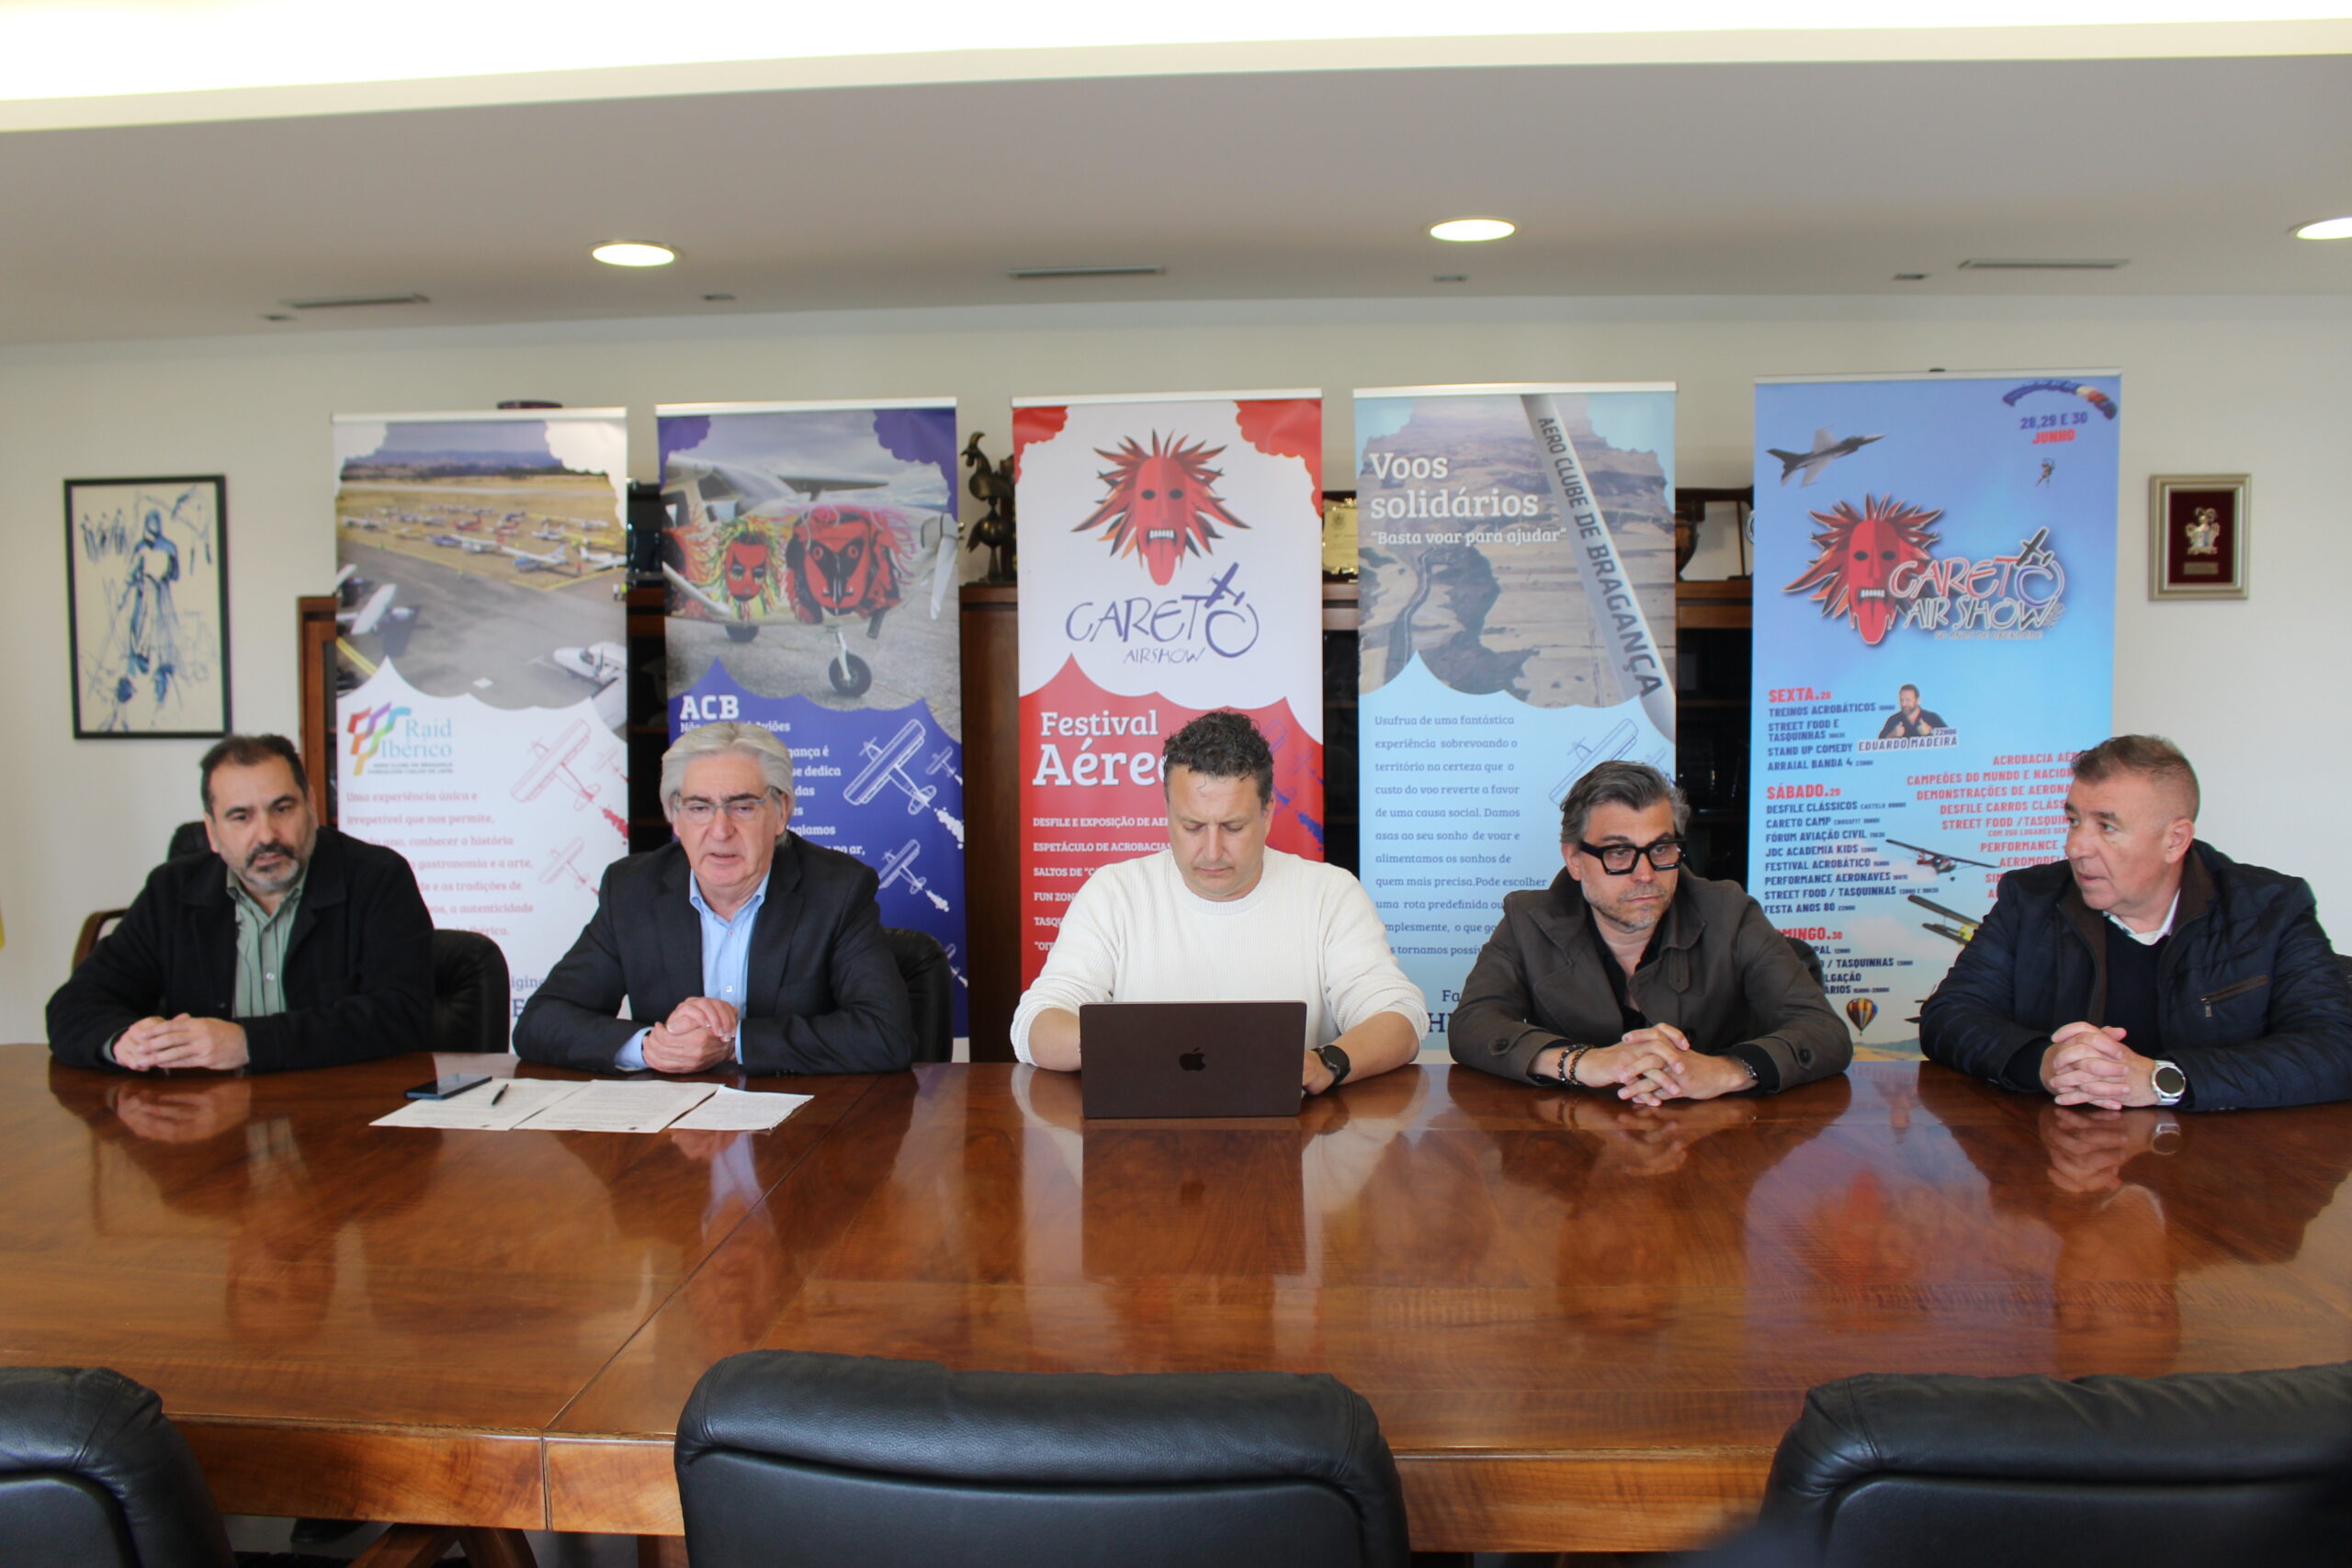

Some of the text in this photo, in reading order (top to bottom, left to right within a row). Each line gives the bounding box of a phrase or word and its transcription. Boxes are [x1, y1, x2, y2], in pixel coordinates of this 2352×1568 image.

[2020, 412, 2088, 430] 28,29 E 30
[2031, 429, 2075, 445] JUNHO
[1370, 452, 1449, 479] Voos
[1370, 487, 1539, 520] solidários
[1426, 531, 1462, 544] voar
[1465, 531, 1503, 547] para
[1538, 417, 1663, 697] AERO CLUBE DE BRAGANÇA
[1889, 556, 2065, 608] CARETO
[1903, 596, 1951, 629] AIR
[1951, 593, 2058, 630] SHOW
[1066, 594, 1259, 659] CARETO
[1123, 647, 1206, 664] AIRSHOW
[679, 694, 740, 720] ACB
[1769, 706, 1809, 717] TREINOS
[1812, 703, 1876, 715] ACROBÁTICOS
[1040, 709, 1159, 737] Festival
[1375, 716, 1417, 726] Usufrua
[1419, 716, 1432, 725] de
[1460, 715, 1514, 725] fantástica
[1768, 718, 1839, 732] STREET FOOD E
[405, 718, 452, 738] Raid
[1769, 730, 1826, 742] TASQUINHAS
[381, 739, 453, 759] Ibérico
[1375, 738, 1436, 750] experiência
[1441, 738, 1509, 748] sobrevoando
[1768, 743, 1853, 757] STAND UP COMEDY
[1859, 736, 1957, 751] EDUARDO MADEIRA
[822, 745, 829, 757] é
[1768, 757, 1853, 771] ARRAIAL BANDA 4
[1993, 753, 2052, 766] ACROBACIA
[804, 765, 841, 777] dedica
[1375, 761, 1424, 771] território
[1442, 762, 1482, 771] certeza
[1485, 763, 1503, 773] que
[1907, 769, 2030, 785] CAMPEÕES DO MUNDO E
[795, 785, 815, 796] das
[1375, 786, 1402, 795] custo
[1405, 784, 1418, 795] do
[1442, 786, 1480, 795] reverte
[1491, 784, 1521, 795] favor
[1917, 784, 2025, 801] DEMONSTRAÇÕES DE
[373, 791, 436, 804] experiência
[439, 791, 469, 801] única
[1375, 808, 1387, 818] de
[1448, 808, 1482, 818] social.
[1484, 808, 1521, 818] Damos
[1767, 804, 1804, 814] DESFILE
[1806, 799, 1859, 811] CLÁSSICOS
[1940, 801, 2029, 815] DESFILE CARROS
[405, 817, 424, 826] que
[427, 816, 446, 824] nos
[1033, 818, 1070, 827] DESFILE
[1072, 818, 1079, 827] E
[1080, 816, 1135, 829] EXPOSIÇÃO
[1137, 818, 1149, 826] DE
[1766, 818, 1803, 829] CARETO
[1805, 817, 1831, 827] CAMP
[1942, 817, 2013, 830] STREET FOOD
[409, 836, 458, 846] conhecer
[470, 835, 513, 846] história
[1375, 832, 1399, 840] asas
[1401, 832, 1414, 840] ao
[1416, 832, 1434, 840] seu
[1436, 831, 1468, 840] sonho
[1473, 831, 1485, 840] de
[1487, 832, 1511, 840] voar
[1766, 829, 1867, 843] FÓRUM AVIAÇÃO CIVIL
[1033, 840, 1093, 852] ESPETÁCULO
[1096, 842, 1109, 852] DE
[1766, 844, 1858, 857] JDC ACADEMIA KIDS
[1980, 840, 2058, 852] PERFORMANCE
[418, 859, 487, 871] gastronomia
[1375, 854, 1443, 863] alimentamos
[1460, 854, 1497, 863] sonhos
[1498, 854, 1511, 863] de
[1765, 857, 1871, 872] FESTIVAL ACROBÁTICO
[1034, 867, 1068, 876] SALTOS
[1069, 867, 1082, 876] DE
[1375, 878, 1404, 887] quem
[1407, 877, 1432, 886] mais
[1503, 877, 1547, 886] escolher
[1765, 874, 1832, 886] PERFORMANCE
[1836, 872, 1891, 883] AERONAVES
[456, 881, 506, 892] tradições
[509, 881, 522, 891] de
[1765, 889, 1799, 900] STREET
[1803, 888, 1826, 898] FOOD
[1829, 888, 1835, 897] /
[1838, 886, 1896, 897] TASQUINHAS
[1034, 892, 1076, 901] FUN ZON
[459, 903, 534, 914] autenticidade
[1376, 901, 1398, 909] uma
[1404, 900, 1425, 909] rota
[1428, 900, 1488, 911] predefinida
[1764, 902, 1836, 914] FESTA ANOS 80
[1384, 922, 1450, 933] mplesmente,
[1464, 924, 1482, 934] que
[1397, 946, 1448, 955] tornamos
[1836, 957, 1894, 968] TASQUINHAS
